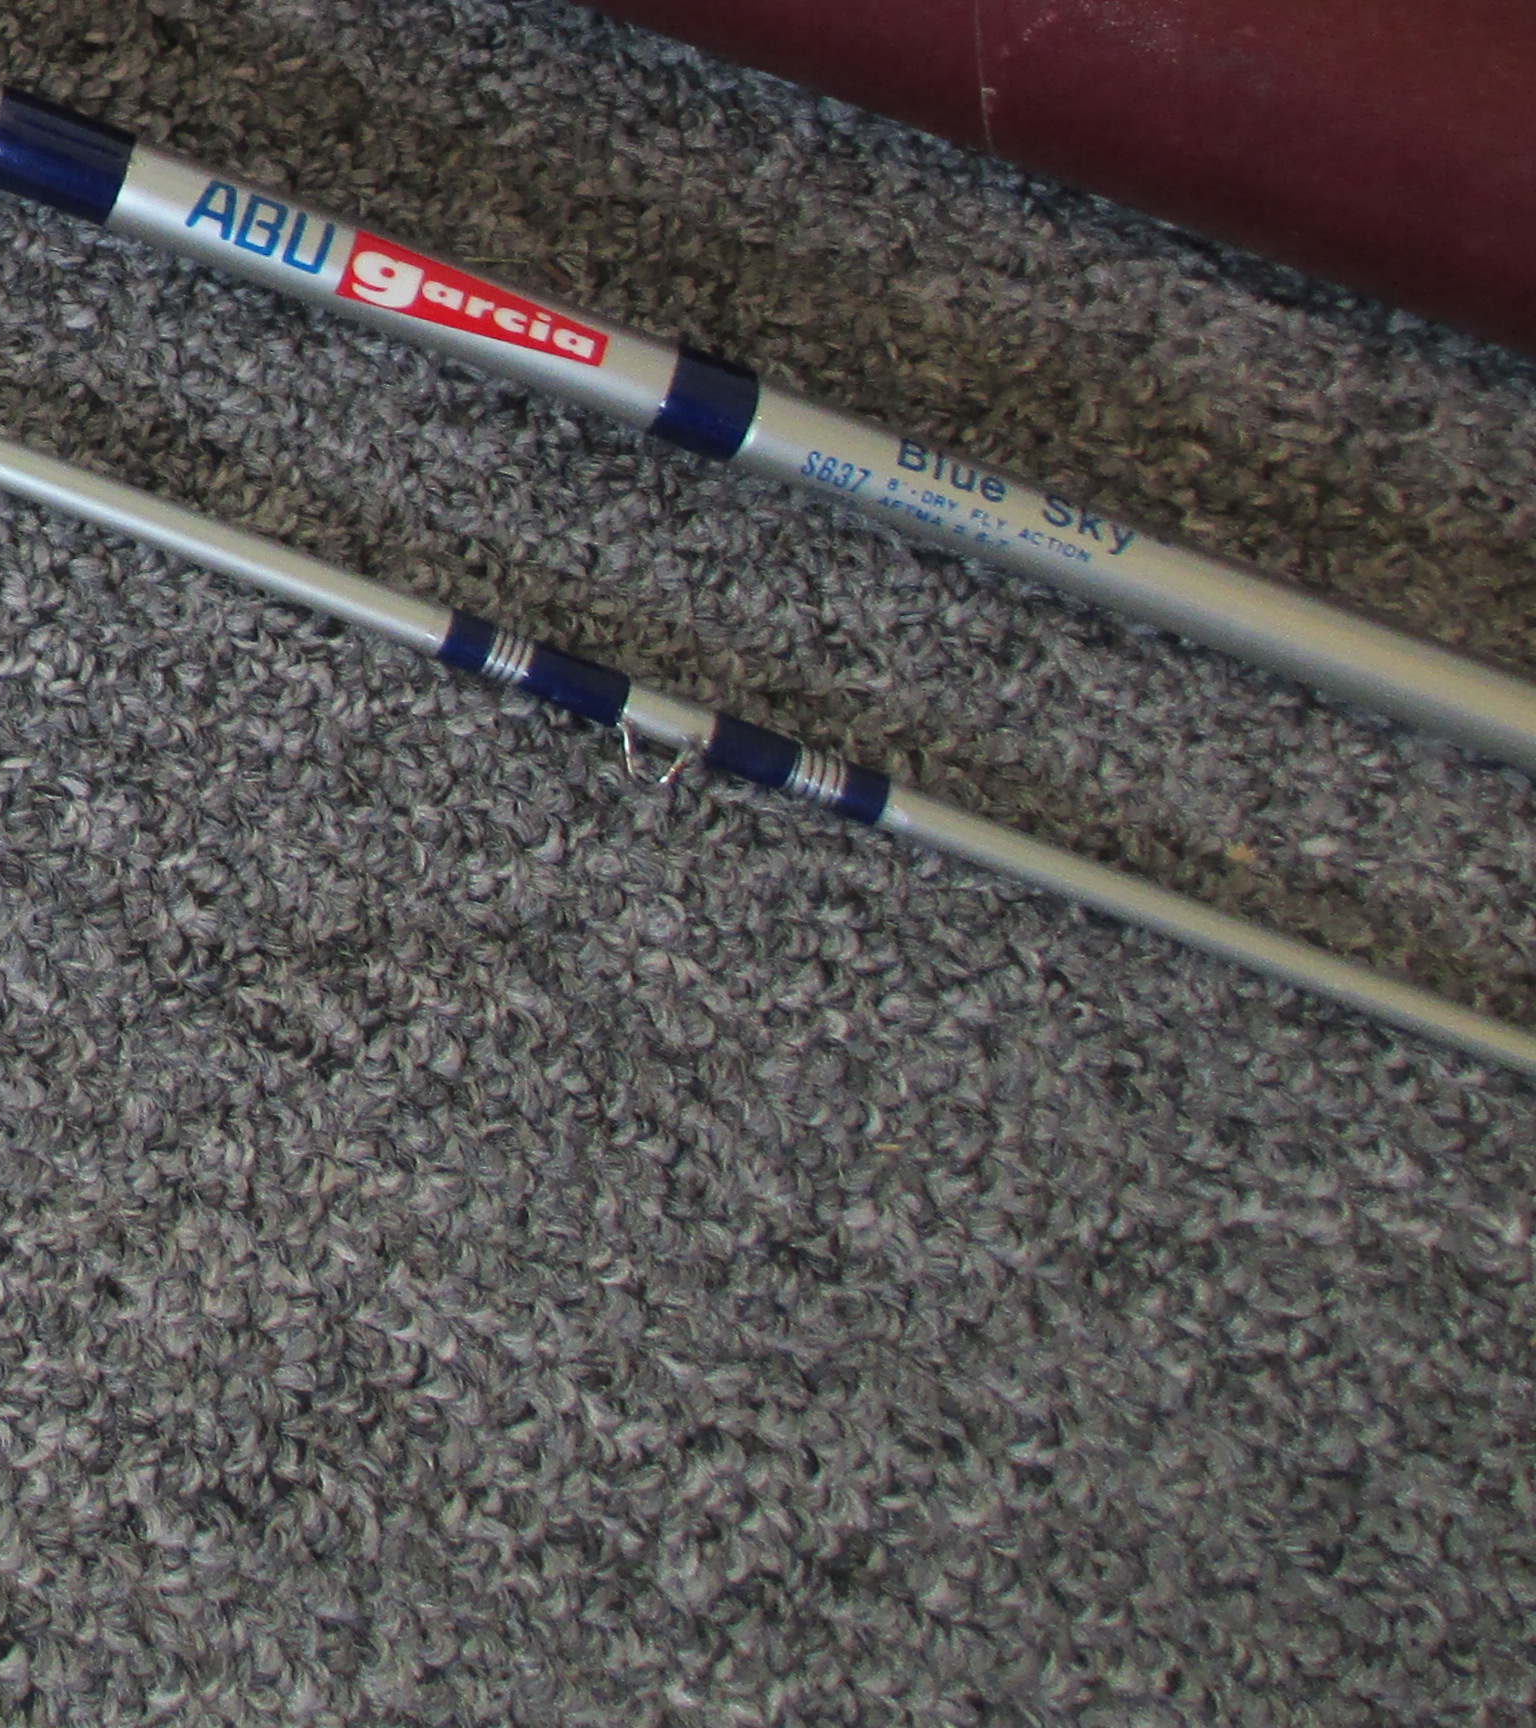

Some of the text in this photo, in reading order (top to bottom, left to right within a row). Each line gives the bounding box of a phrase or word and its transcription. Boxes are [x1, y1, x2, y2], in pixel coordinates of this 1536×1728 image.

[185, 180, 597, 361] ABU garcia
[897, 438, 1134, 555] Blue Sky
[1018, 528, 1092, 562] ACTION
